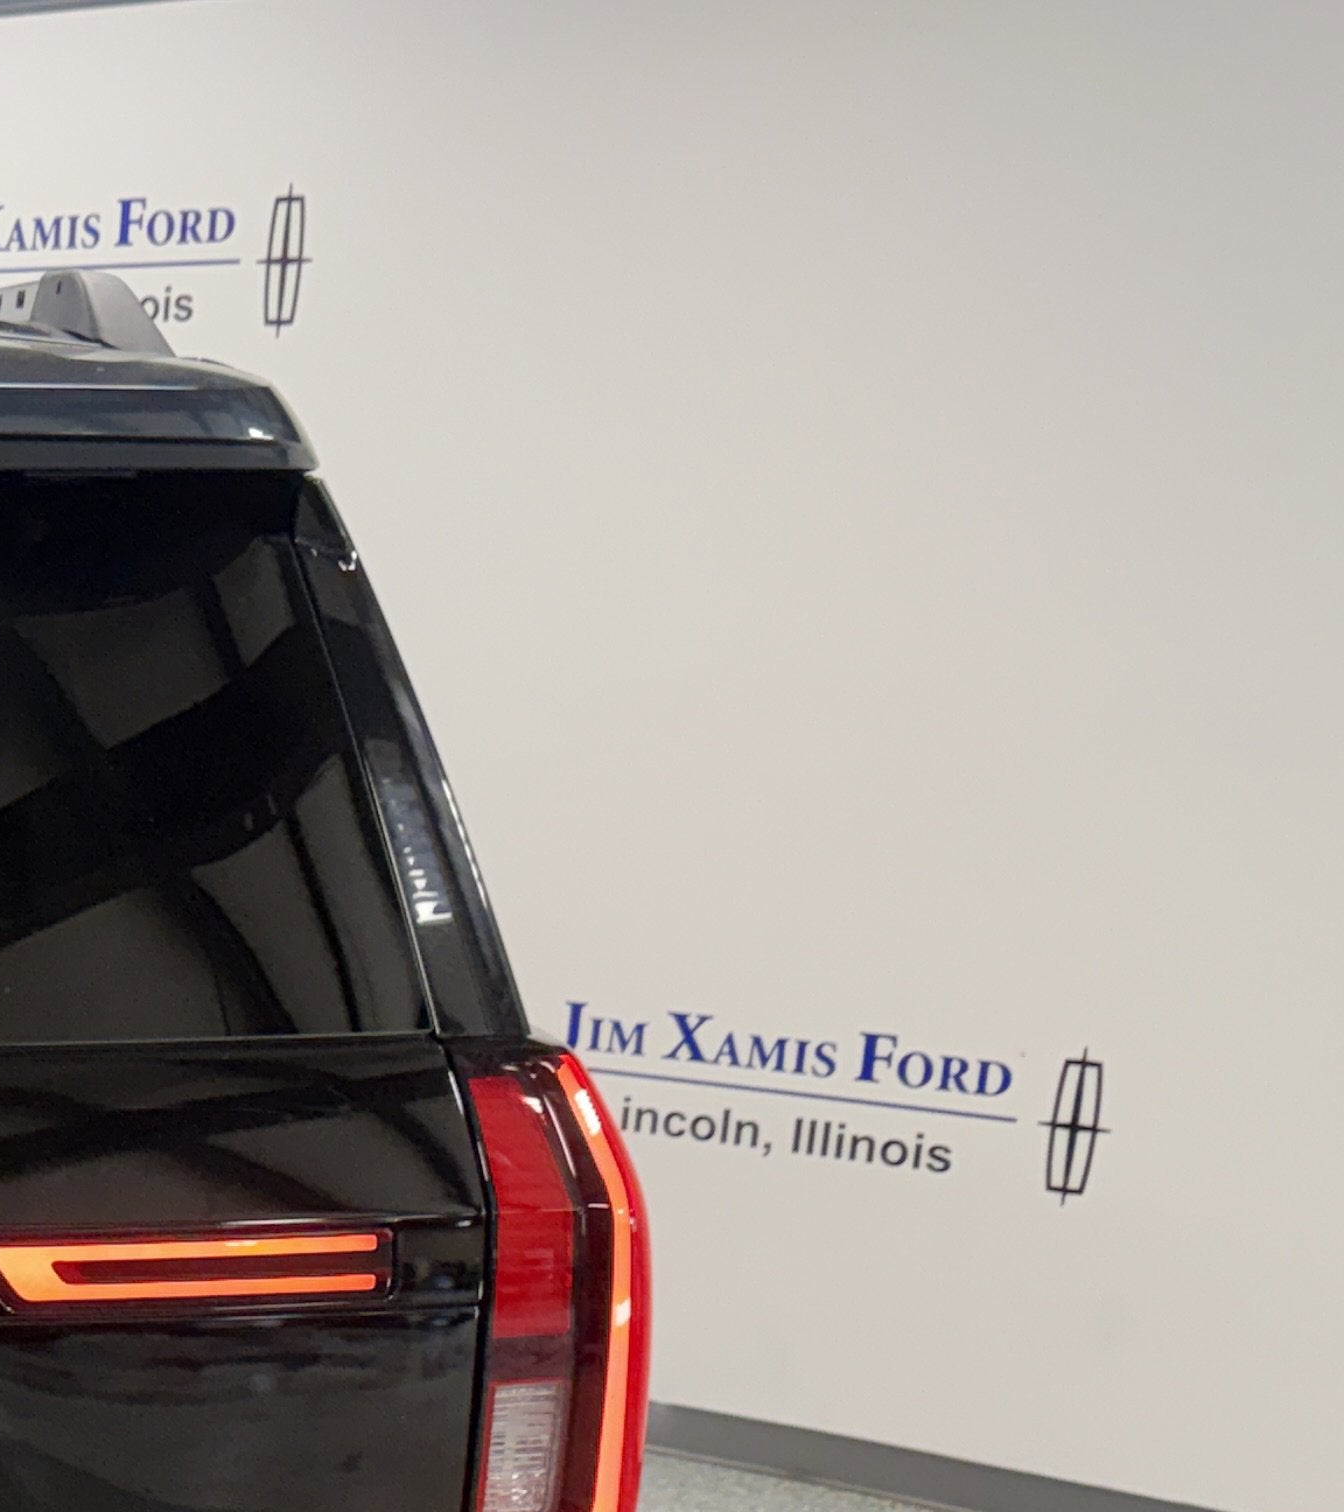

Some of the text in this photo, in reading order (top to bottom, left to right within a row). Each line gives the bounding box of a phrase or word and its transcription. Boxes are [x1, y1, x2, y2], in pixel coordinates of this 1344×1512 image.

[114, 197, 236, 247] FORD
[565, 999, 1012, 1096] JIM XAMIS FORD
[620, 1097, 952, 1173] incoln, Illinois
